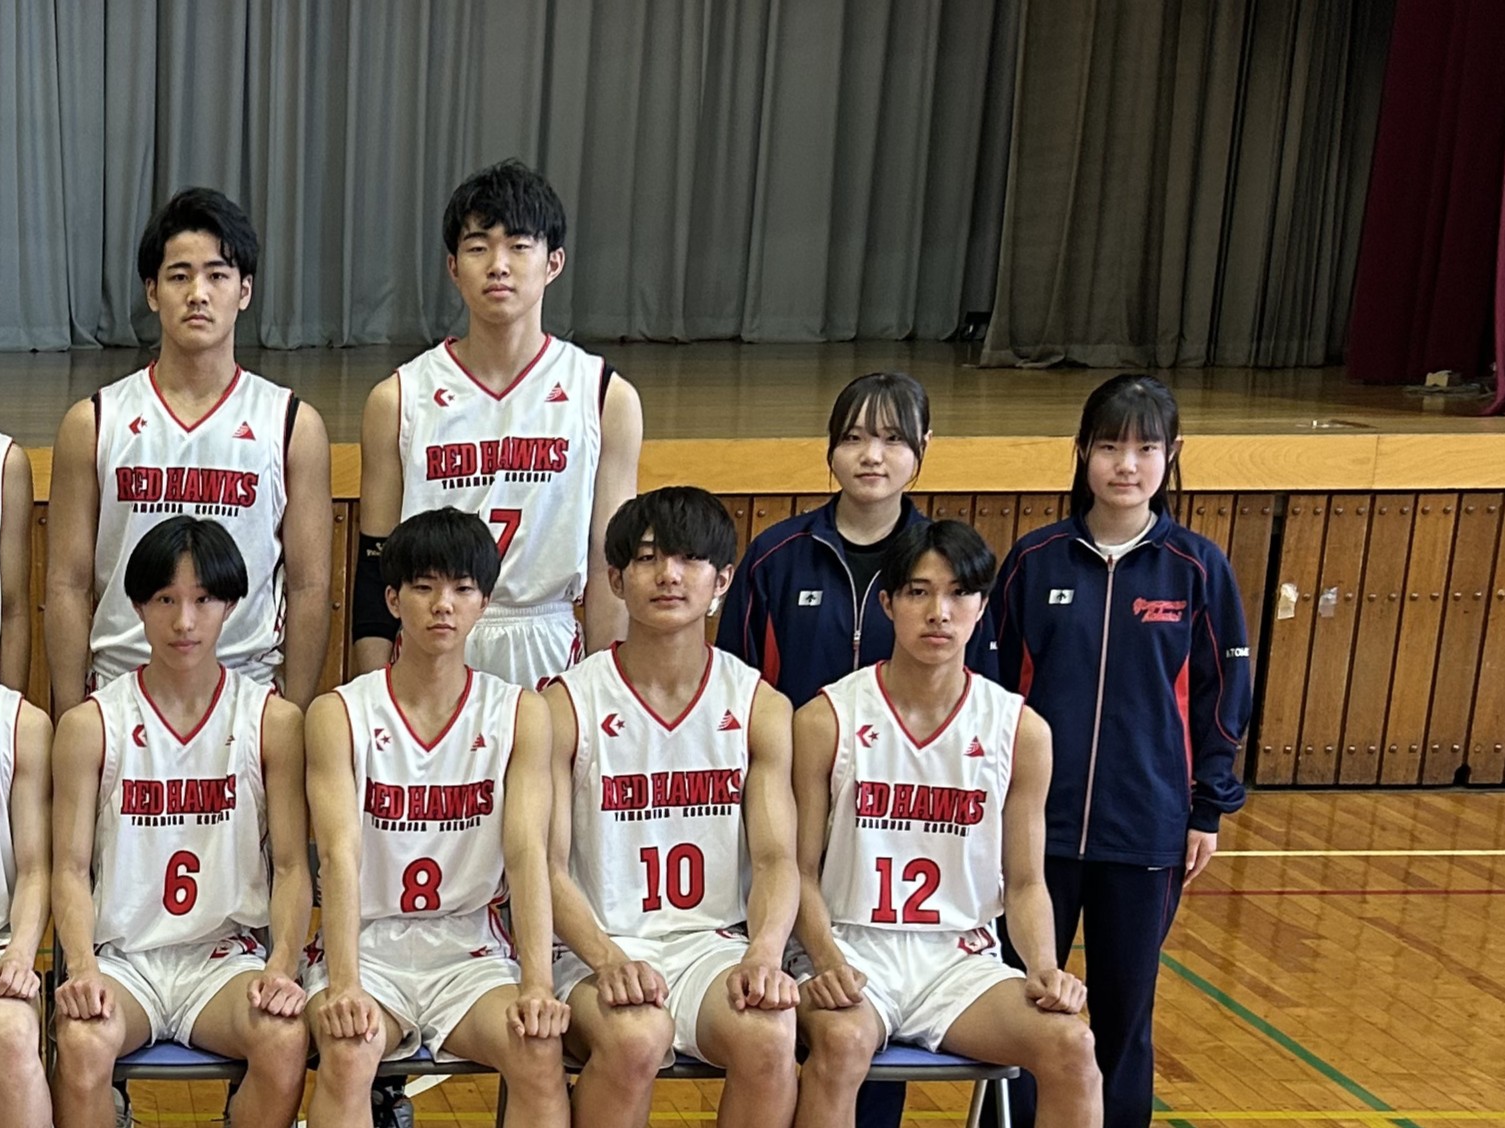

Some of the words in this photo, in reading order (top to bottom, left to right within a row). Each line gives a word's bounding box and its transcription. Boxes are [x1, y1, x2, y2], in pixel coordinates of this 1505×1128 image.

[426, 443, 478, 481] RED
[479, 436, 569, 475] HAWKS
[115, 466, 163, 502] RED
[163, 466, 259, 508] HAWKS
[442, 476, 495, 490] YAMAMUR
[133, 503, 183, 513] AMAMURA
[120, 779, 164, 815] RED
[364, 776, 405, 820] RED
[407, 779, 495, 821] HAWKS
[601, 774, 649, 811] RED
[651, 768, 742, 808] HAWKS
[890, 783, 987, 825] HAWKS
[923, 822, 970, 837] KOKUSA
[162, 850, 201, 916] 6
[400, 857, 443, 913] 8
[639, 842, 705, 913] 10
[870, 857, 941, 925] 12
